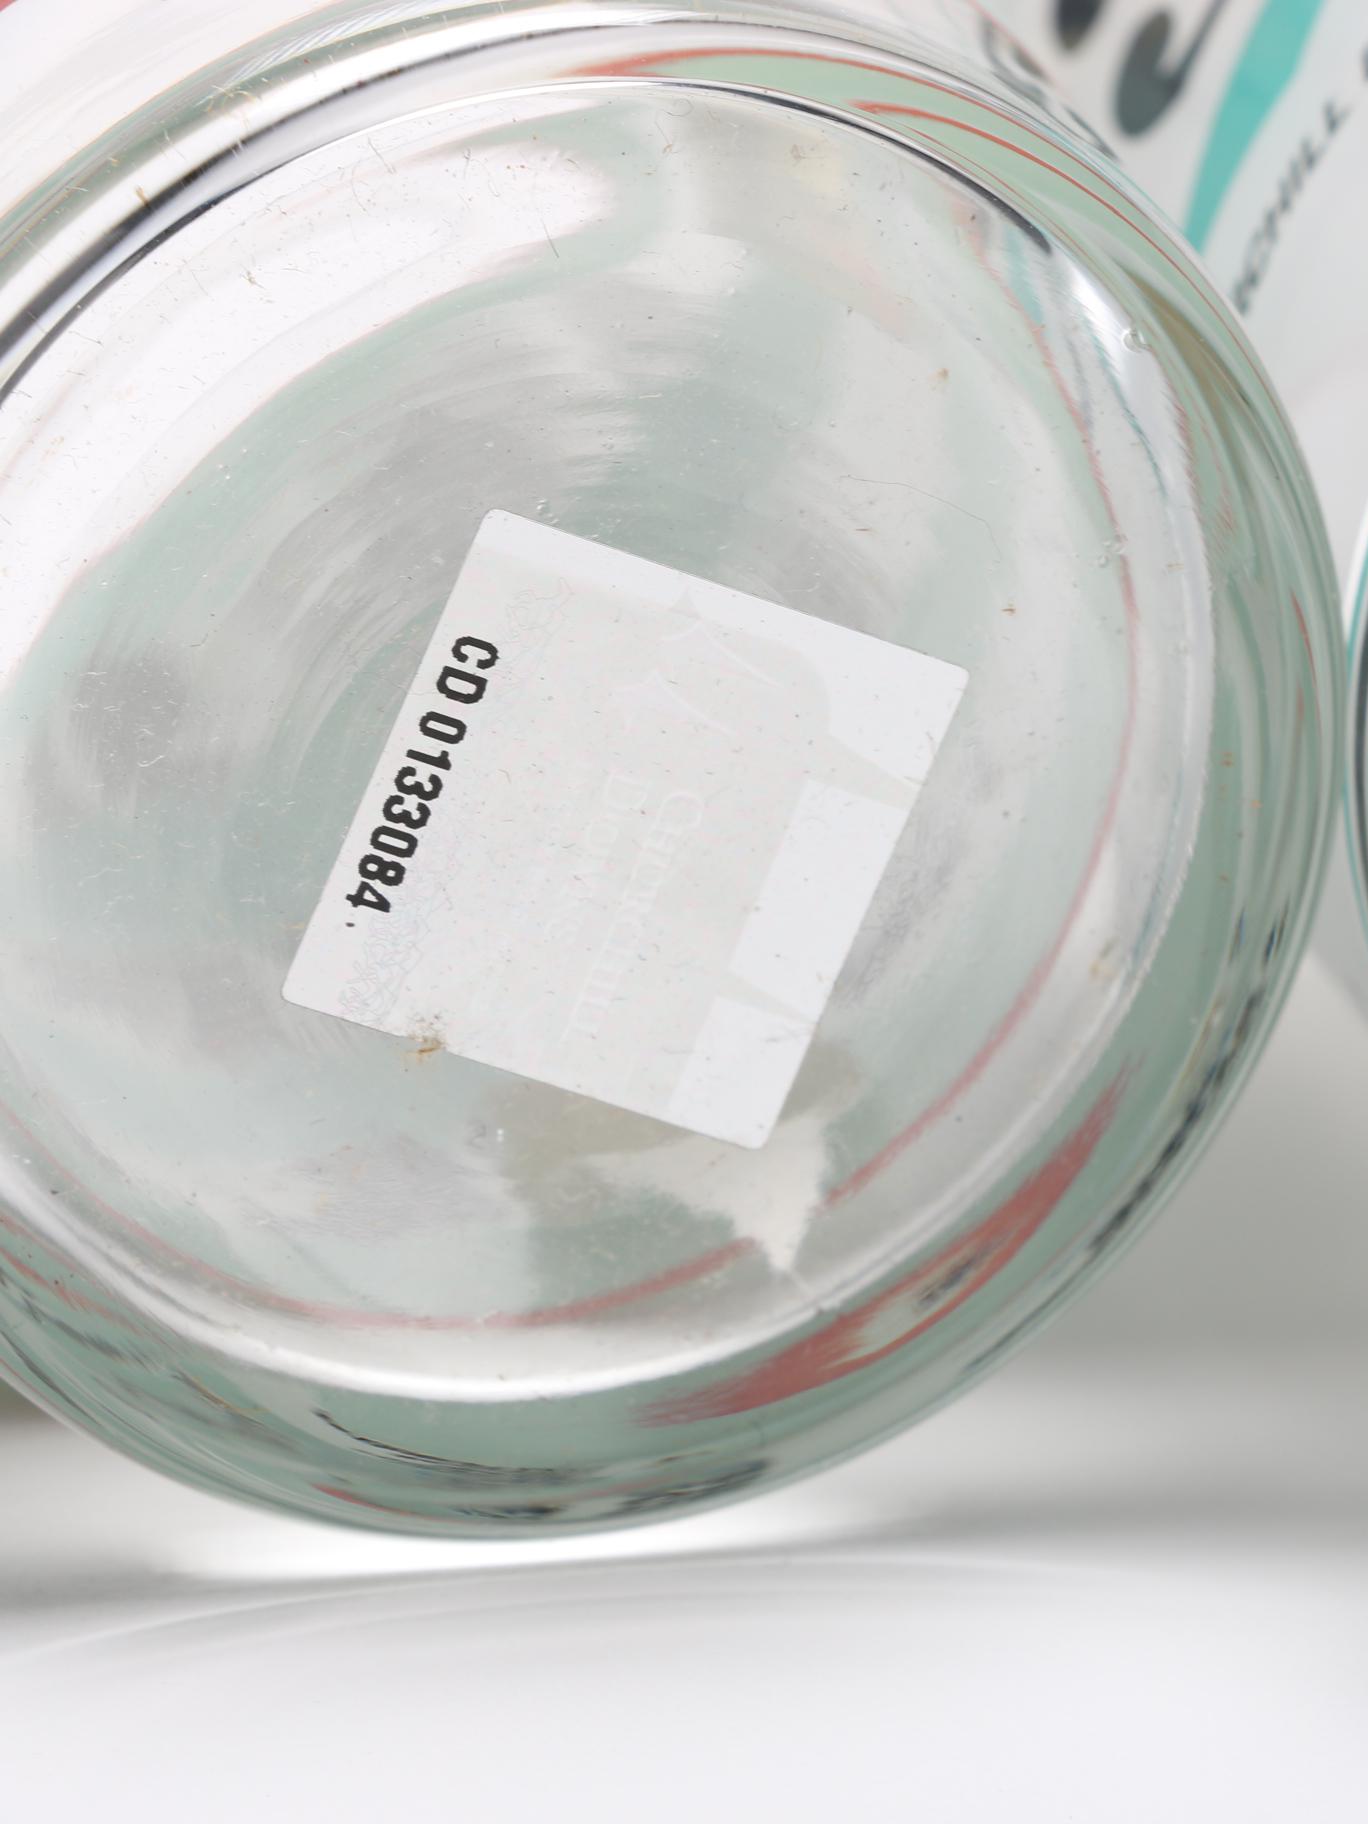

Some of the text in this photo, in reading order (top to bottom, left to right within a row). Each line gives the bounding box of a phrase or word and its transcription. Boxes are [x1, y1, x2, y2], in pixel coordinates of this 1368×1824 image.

[1231, 97, 1354, 317] RCHILL
[346, 635, 499, 913] CD 0133084
